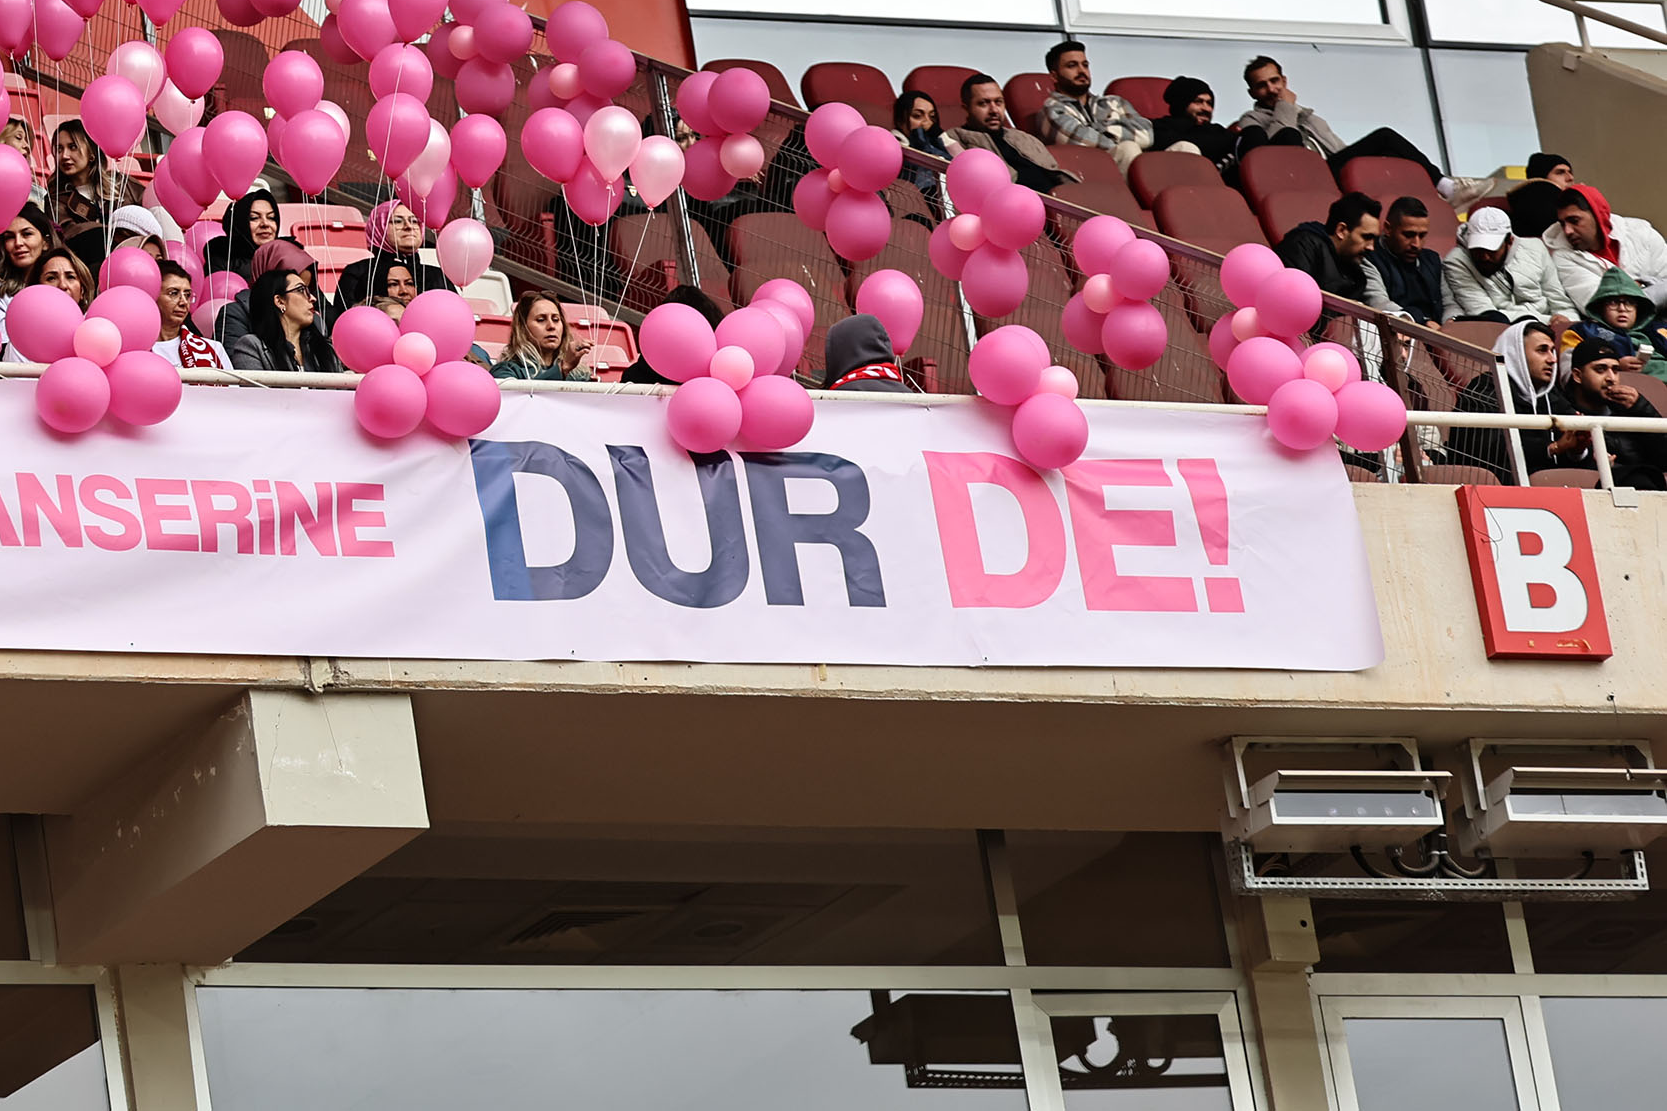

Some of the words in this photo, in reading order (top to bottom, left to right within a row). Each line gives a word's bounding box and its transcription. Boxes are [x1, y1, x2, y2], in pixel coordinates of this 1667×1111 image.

[467, 438, 887, 608] DUR
[922, 450, 1245, 614] DE!
[1483, 507, 1588, 633] B
